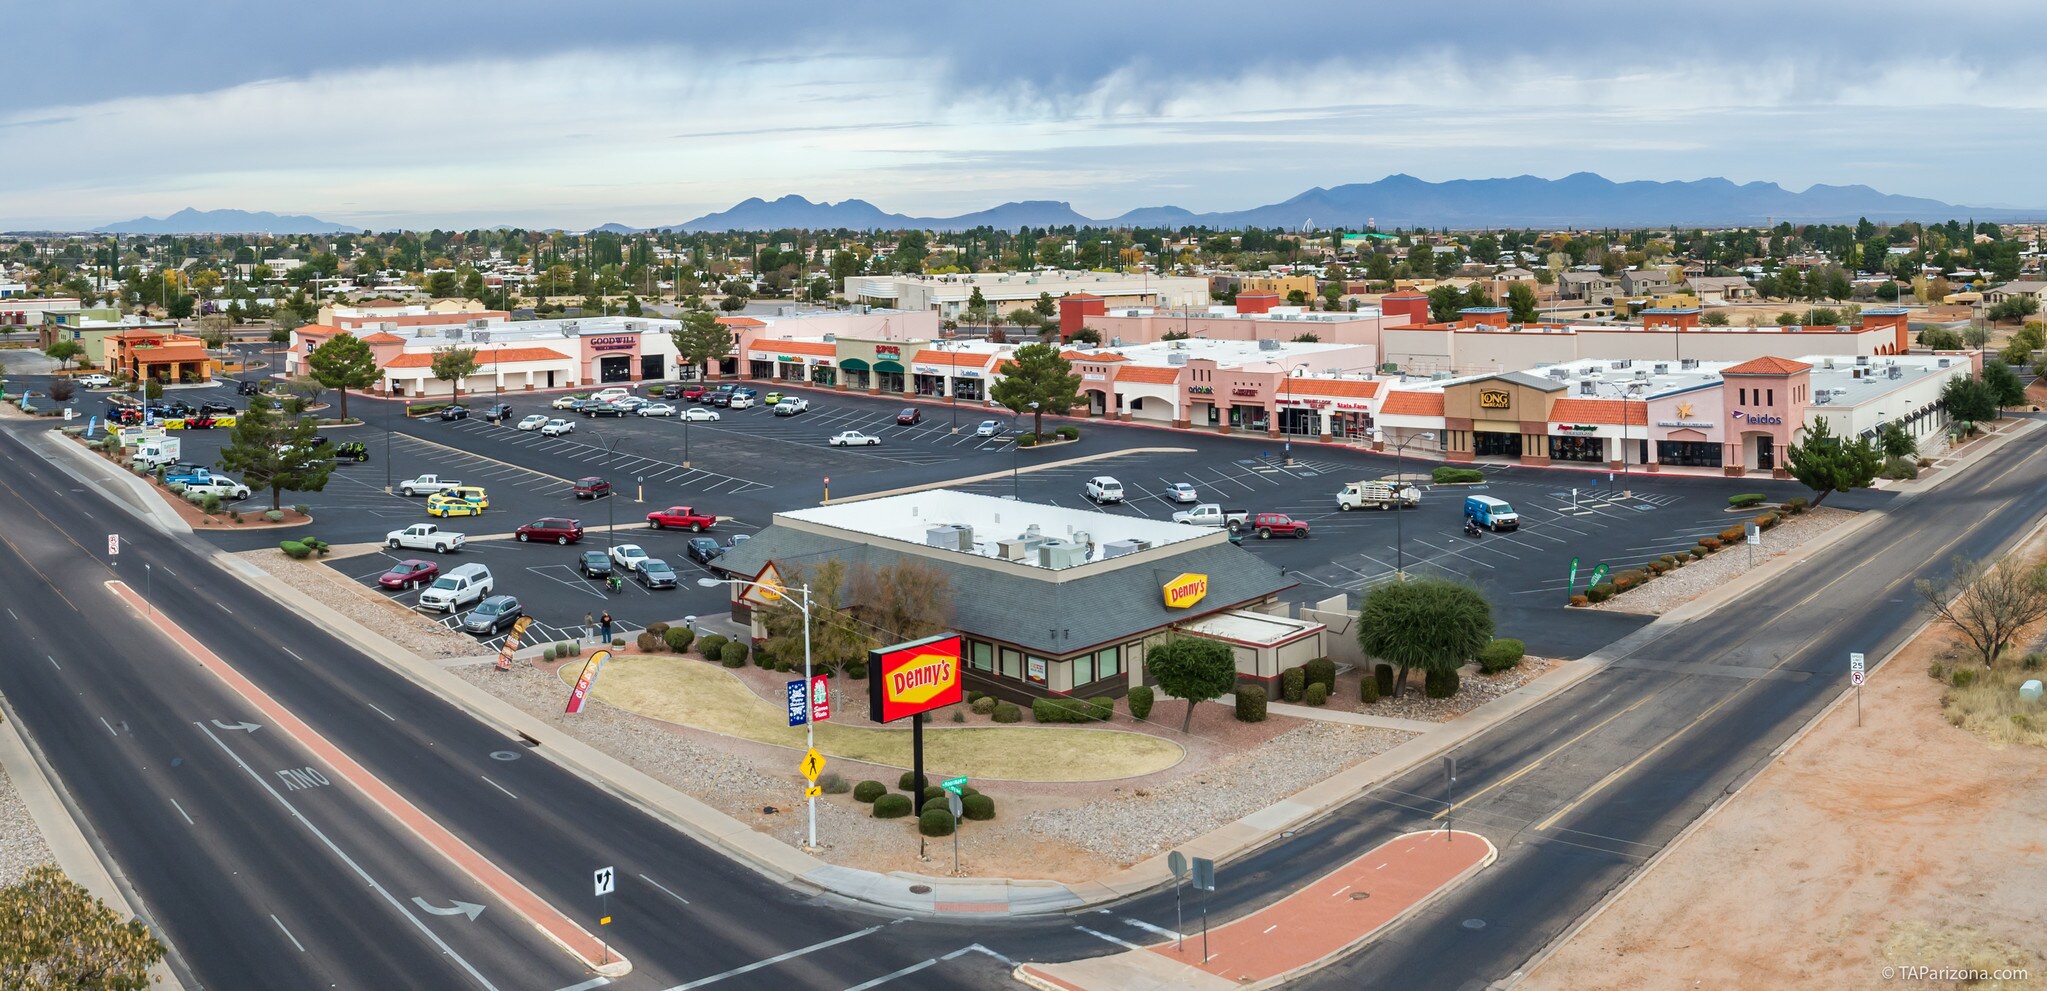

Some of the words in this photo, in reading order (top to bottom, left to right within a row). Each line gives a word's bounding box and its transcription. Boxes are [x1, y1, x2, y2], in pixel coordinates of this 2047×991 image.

[590, 336, 636, 345] GOODWILL
[1481, 393, 1508, 407] LONG
[1746, 414, 1782, 425] leidos
[1171, 579, 1205, 603] Denny's
[894, 660, 950, 695] Denny's
[275, 766, 330, 790] ONLY
